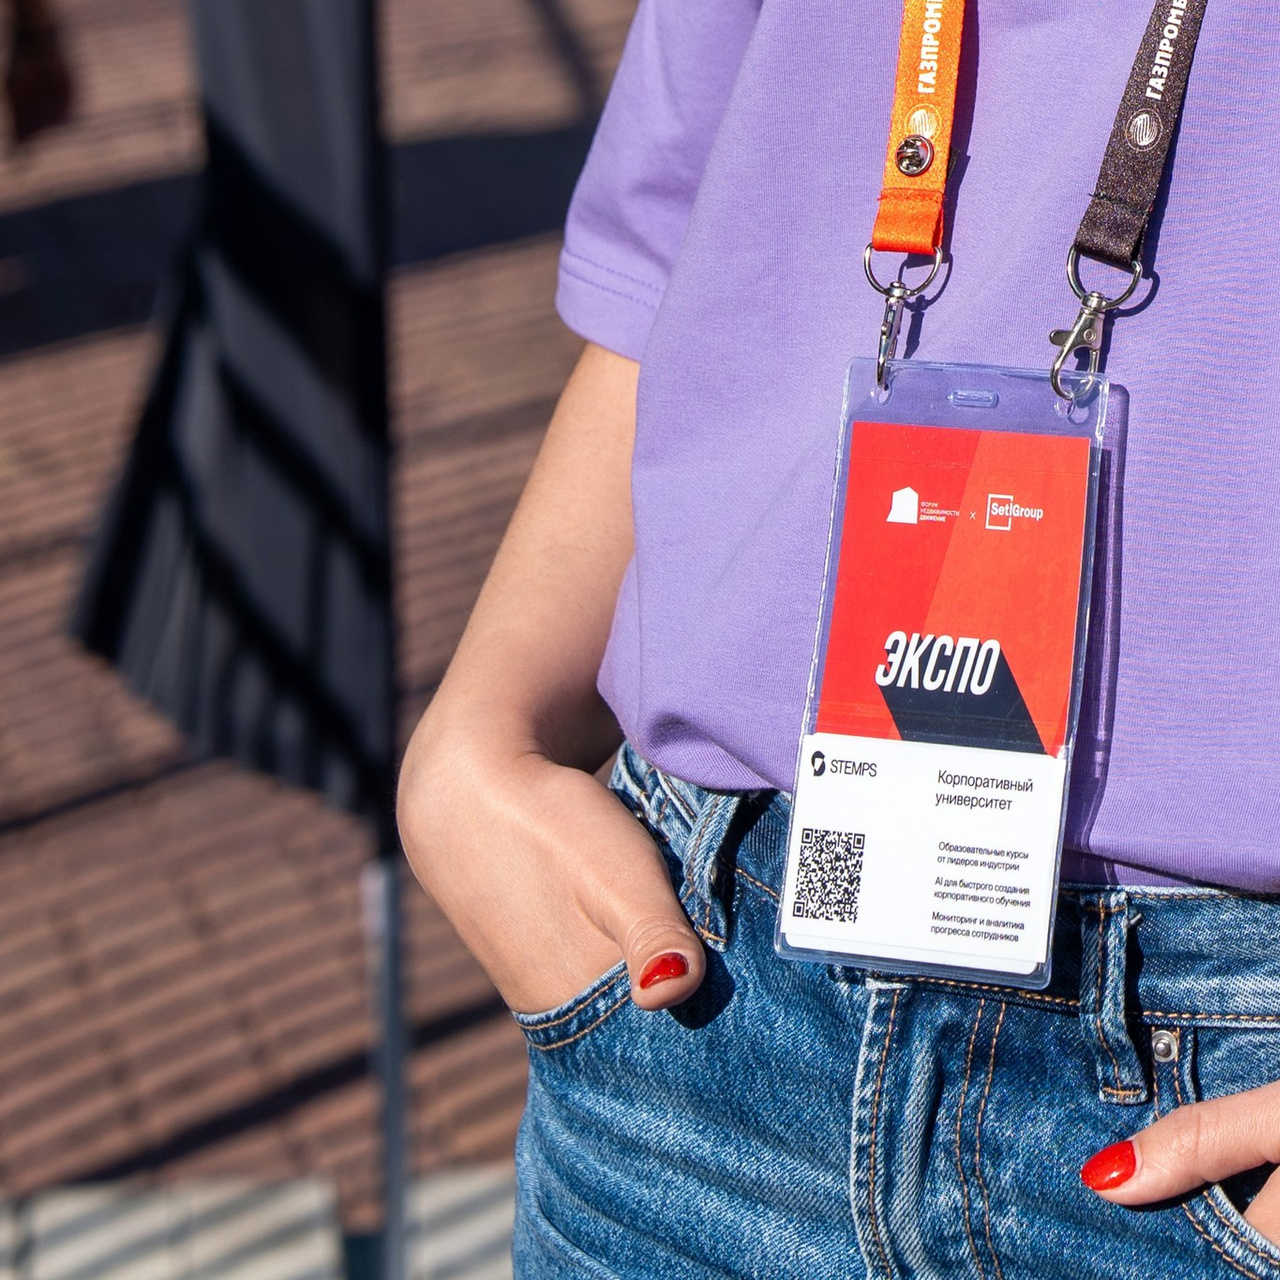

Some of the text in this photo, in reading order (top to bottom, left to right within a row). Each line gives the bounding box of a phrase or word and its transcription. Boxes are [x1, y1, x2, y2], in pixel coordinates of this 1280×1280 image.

[874, 630, 1001, 696] ЭКСПО
[830, 759, 877, 777] STEMPS
[937, 769, 1034, 793] Корпоративный
[935, 793, 1013, 811] университет
[938, 841, 1029, 860] Образовательные курсы
[937, 855, 1020, 871] от лидеров индустрии
[943, 879, 958, 888] для
[959, 879, 993, 891] быстрого
[994, 884, 1030, 895] создания
[934, 890, 1031, 908] корпоративного обучения
[931, 911, 1025, 930] Мониторинг и аналитика
[930, 925, 1019, 943] прогресса сотрудников
